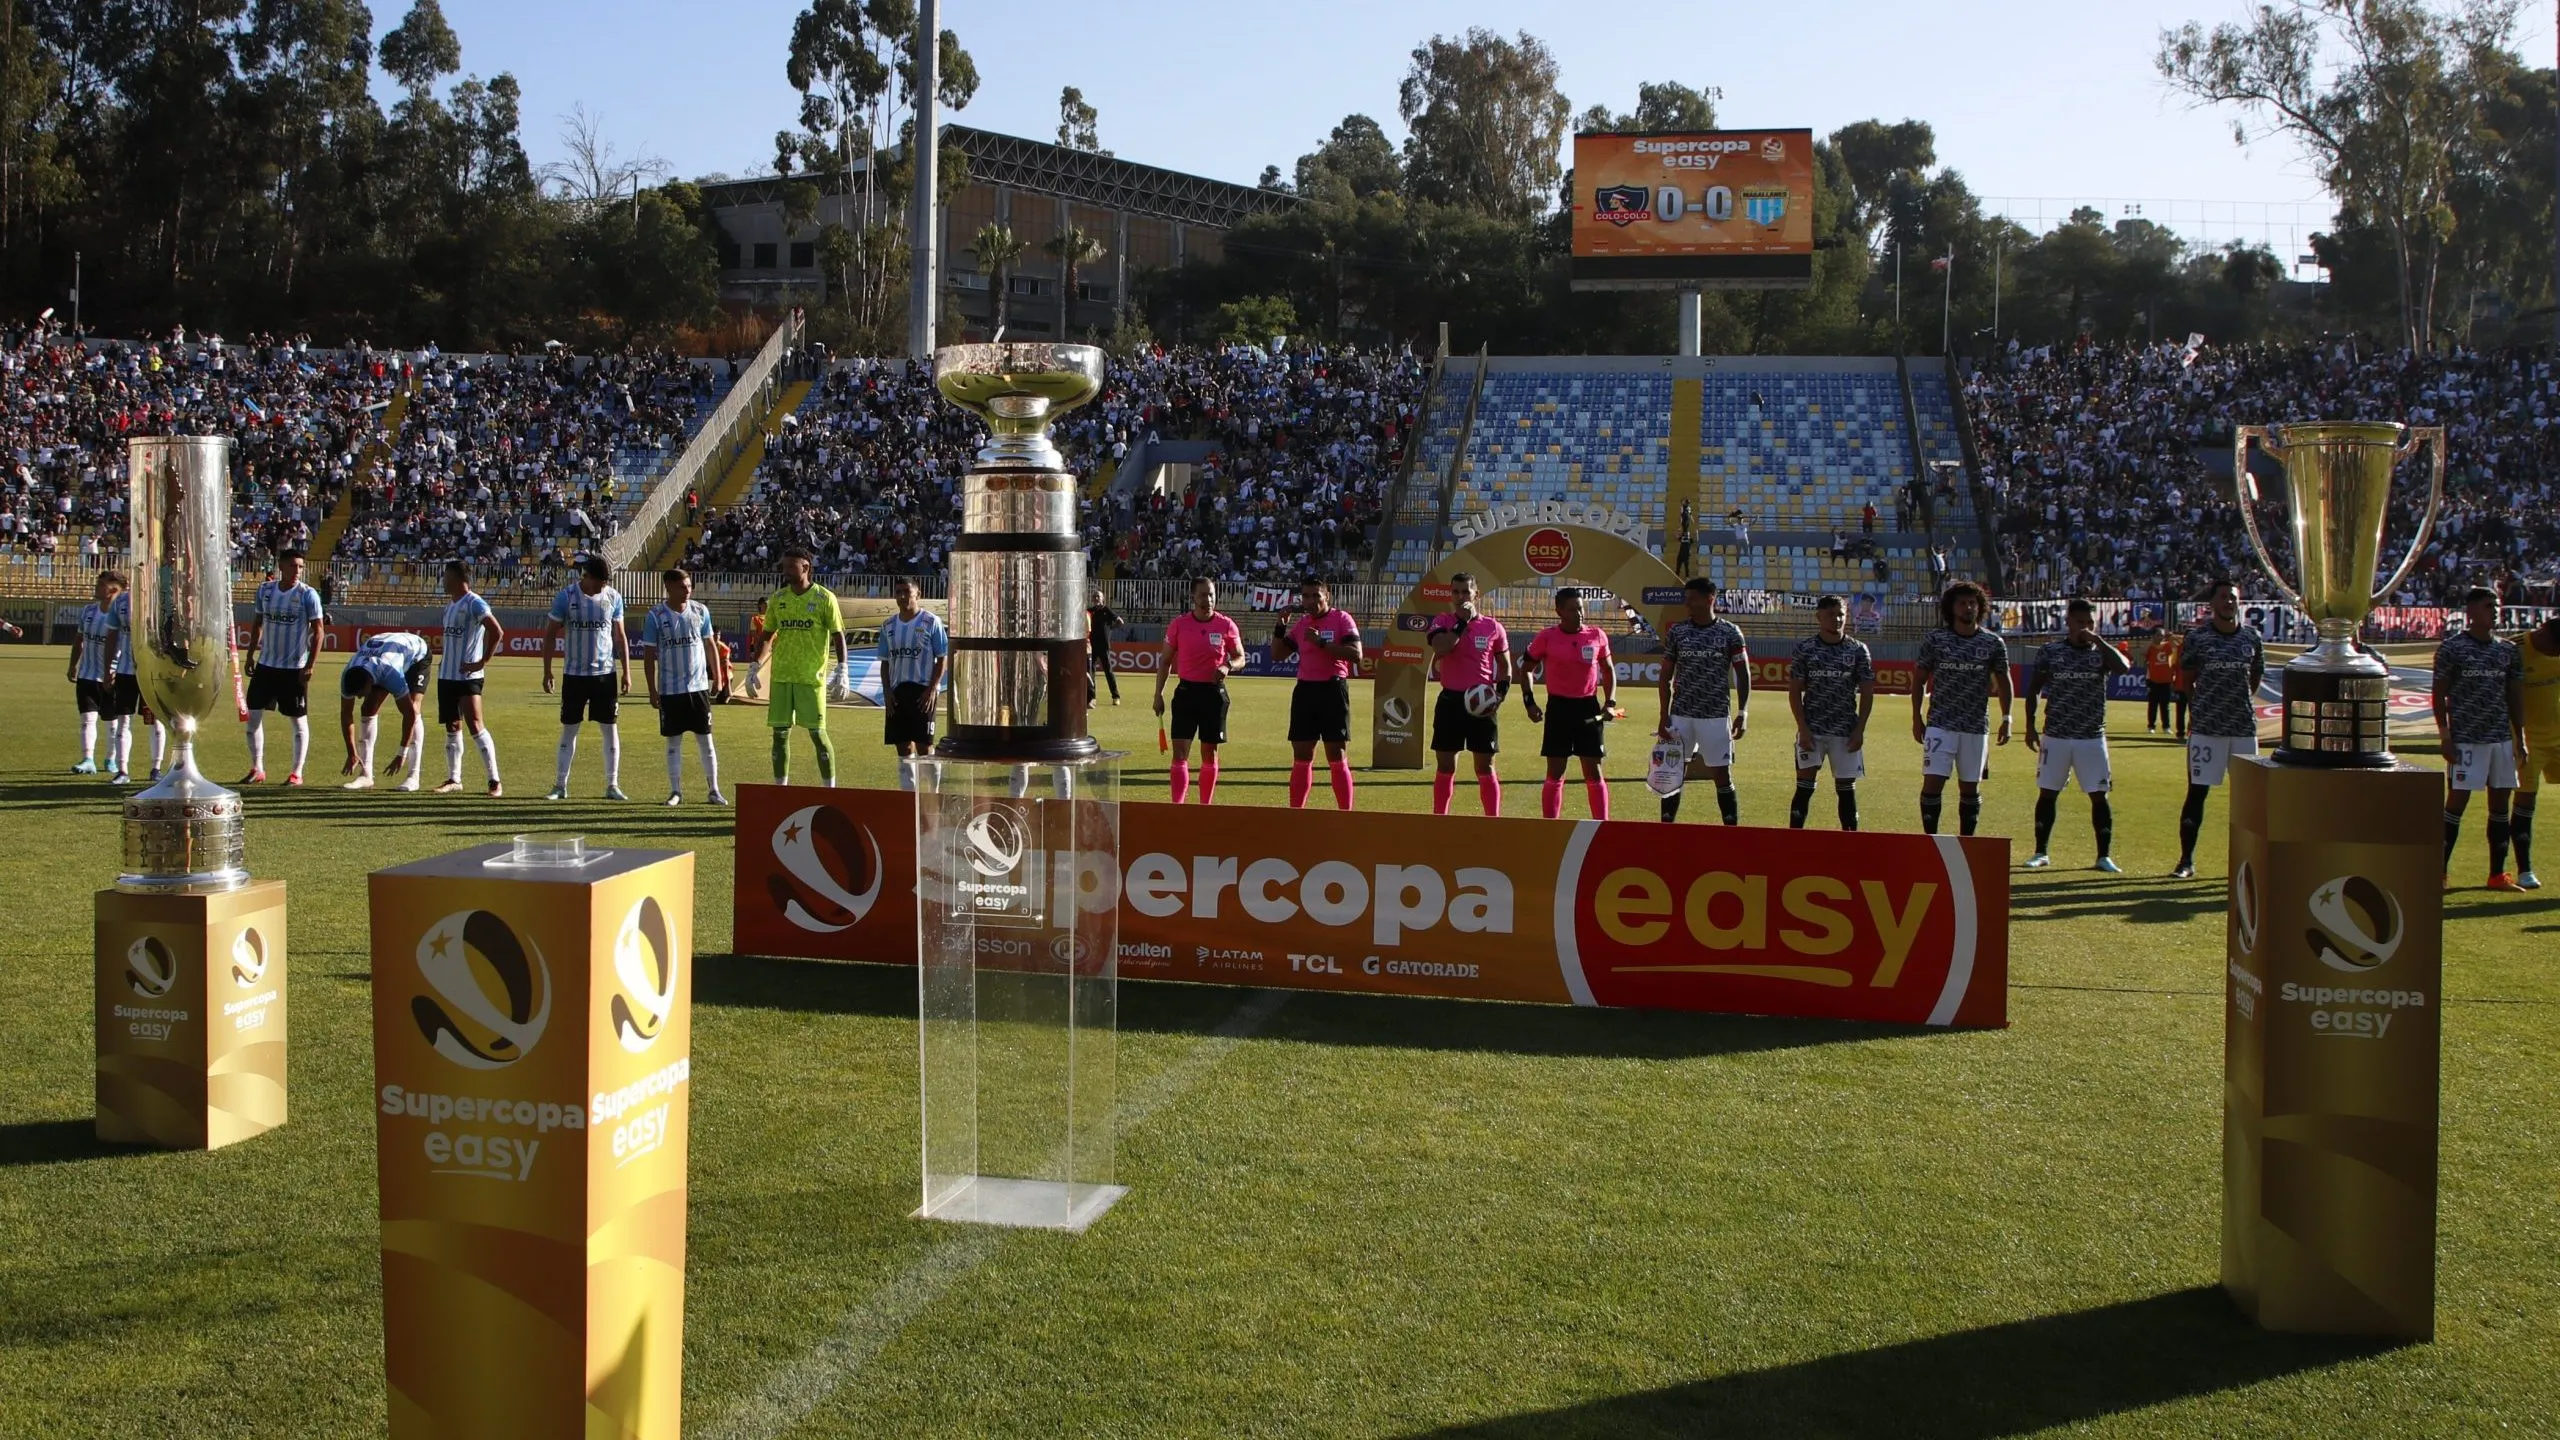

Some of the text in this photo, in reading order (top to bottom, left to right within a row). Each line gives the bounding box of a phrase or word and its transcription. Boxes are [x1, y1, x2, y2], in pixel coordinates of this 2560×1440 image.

[1633, 140, 1750, 155] Supercopa
[1663, 154, 1720, 169] easy
[1656, 185, 1733, 223] 0-0
[1147, 430, 1160, 445] A
[1452, 501, 1650, 549] SUPERCOPA
[1528, 544, 1570, 559] easy
[1424, 588, 1452, 597] betss
[926, 721, 936, 735] 19
[2191, 745, 2212, 763] 23
[958, 881, 1027, 896] Supercopa
[975, 896, 1009, 910] easy
[1595, 867, 1939, 988] easy
[1116, 942, 1172, 958] molten
[1213, 949, 1263, 961] LATAM
[1212, 963, 1263, 971] AIRLINES
[1287, 953, 1343, 974] TCL
[1386, 960, 1479, 978] GATORADE
[224, 989, 277, 1016] Supercopa
[2281, 982, 2425, 1009] Supercopa
[114, 1004, 188, 1022] Supercopa
[235, 1009, 267, 1030] easy
[129, 1022, 172, 1040] easy
[2310, 1009, 2393, 1039] easy
[591, 1057, 689, 1126] Supercopa
[381, 1084, 585, 1132] Supercopa
[612, 1102, 670, 1162] easy
[424, 1131, 540, 1181] easy
